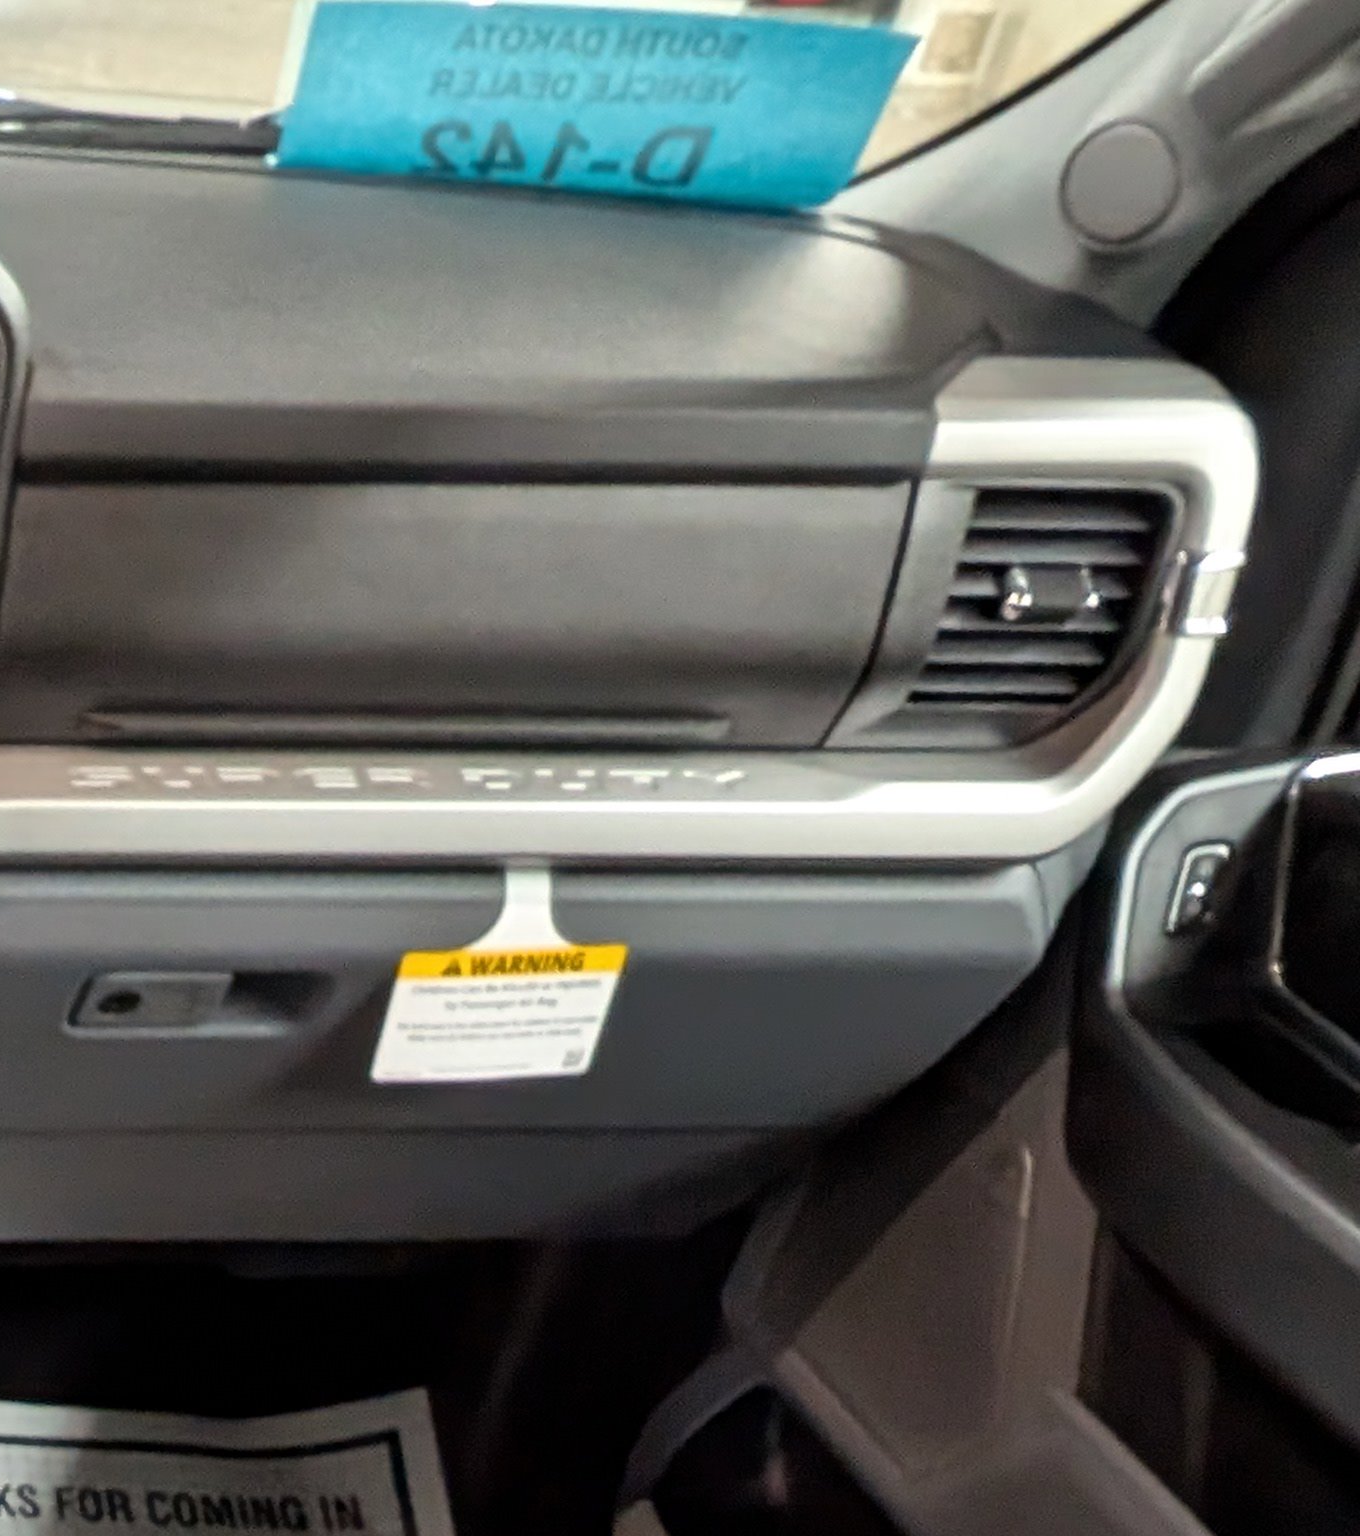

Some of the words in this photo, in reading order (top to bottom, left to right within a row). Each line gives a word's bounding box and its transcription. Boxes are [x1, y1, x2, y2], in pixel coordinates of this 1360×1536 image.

[469, 953, 586, 977] WARNING
[55, 1485, 134, 1523] FOR
[146, 1490, 309, 1531] COMING
[318, 1494, 365, 1532] IN
